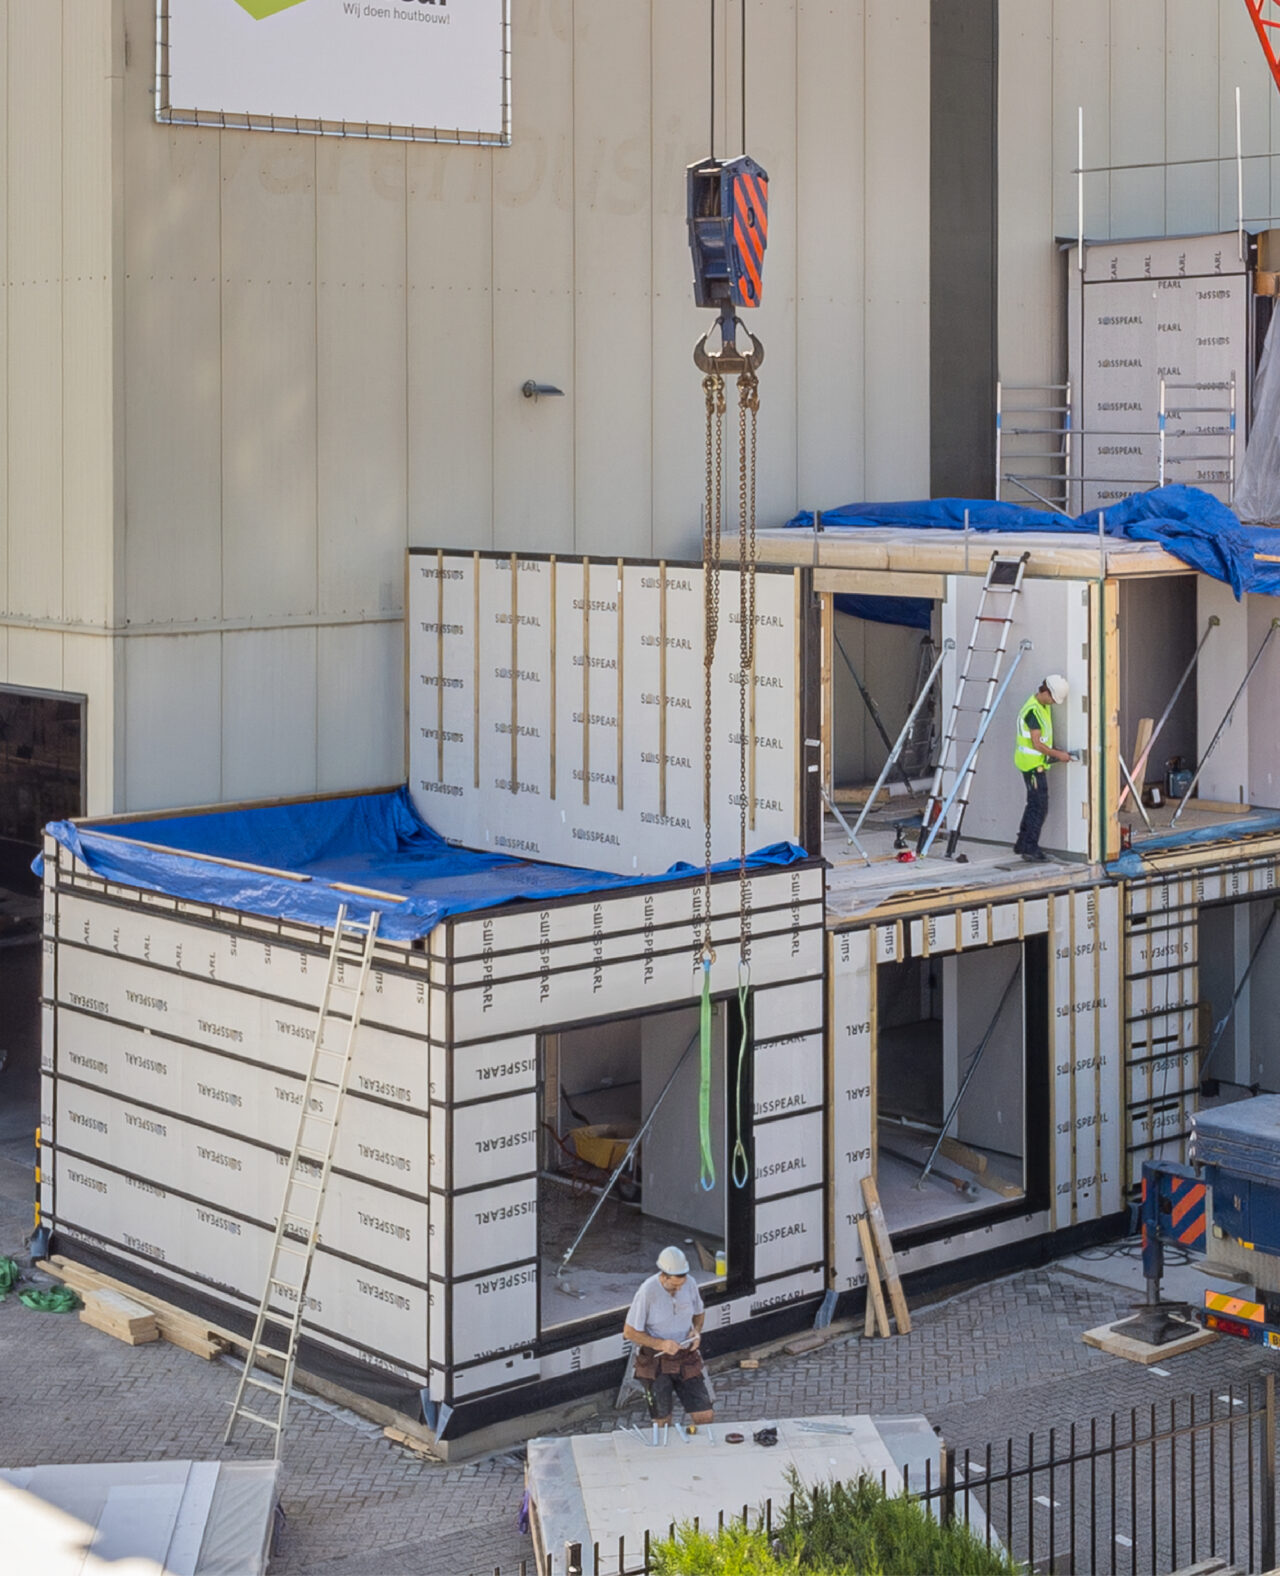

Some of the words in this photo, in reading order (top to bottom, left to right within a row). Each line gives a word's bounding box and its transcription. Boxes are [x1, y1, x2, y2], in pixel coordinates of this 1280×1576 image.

[343, 3, 360, 18] Wij
[363, 5, 390, 18] doen
[393, 8, 450, 24] houtbouw!
[1158, 324, 1181, 332] PEARL
[641, 577, 692, 591] SWISPEARL
[641, 635, 692, 650] SWISPEARL
[641, 693, 692, 709] SWISPEARL
[640, 752, 692, 768] SWISPEARL
[640, 812, 691, 829] SWISSPEARL
[494, 835, 540, 853] SWISSPEARL
[572, 828, 620, 846] SWISSPEARL
[198, 1019, 243, 1042] SWISSPEARL
[197, 1083, 242, 1107] SWISSPEARL
[358, 1075, 411, 1101] SWISSPEARL
[197, 1146, 242, 1171] SWISSPEARL
[358, 1144, 411, 1171] SWISSPEARL
[196, 1209, 241, 1236] SWISSPEARL
[358, 1211, 410, 1241] SWISSPEARL
[356, 1279, 410, 1311] SWISSPEARL
